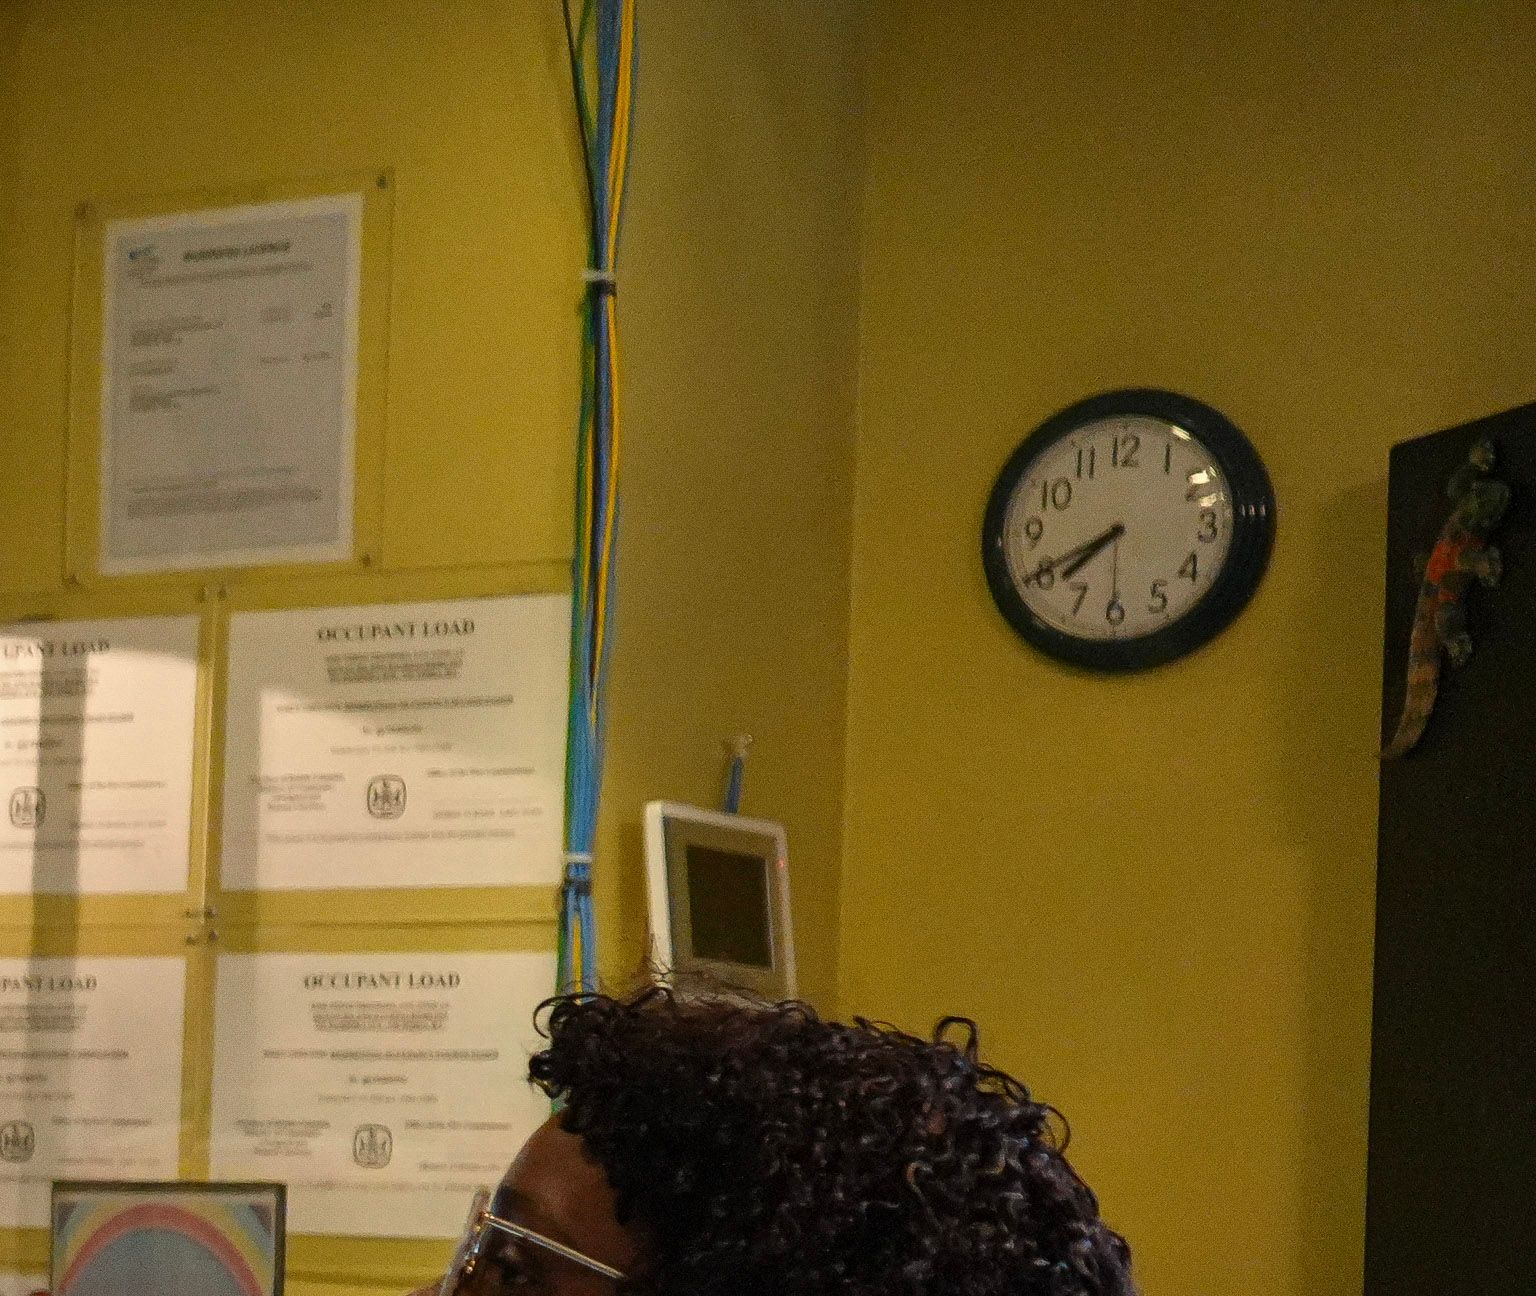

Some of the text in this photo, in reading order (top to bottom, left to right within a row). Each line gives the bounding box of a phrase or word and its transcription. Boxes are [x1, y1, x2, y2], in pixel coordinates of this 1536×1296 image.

[1076, 445, 1095, 480] 11
[1111, 434, 1141, 468] 12
[1163, 442, 1172, 475] 1
[1041, 479, 1073, 511] 10
[1025, 515, 1044, 550] 9
[1197, 508, 1219, 543] 3
[1177, 551, 1198, 583] 4
[1070, 581, 1089, 617] 7
[1106, 594, 1125, 625] 6
[1148, 580, 1169, 614] 5
[317, 618, 475, 641] OCCUPANT LOAD
[59, 638, 110, 656] LOAD
[47, 974, 97, 992] LOAD
[304, 971, 460, 991] OCCUPANT LOAD
